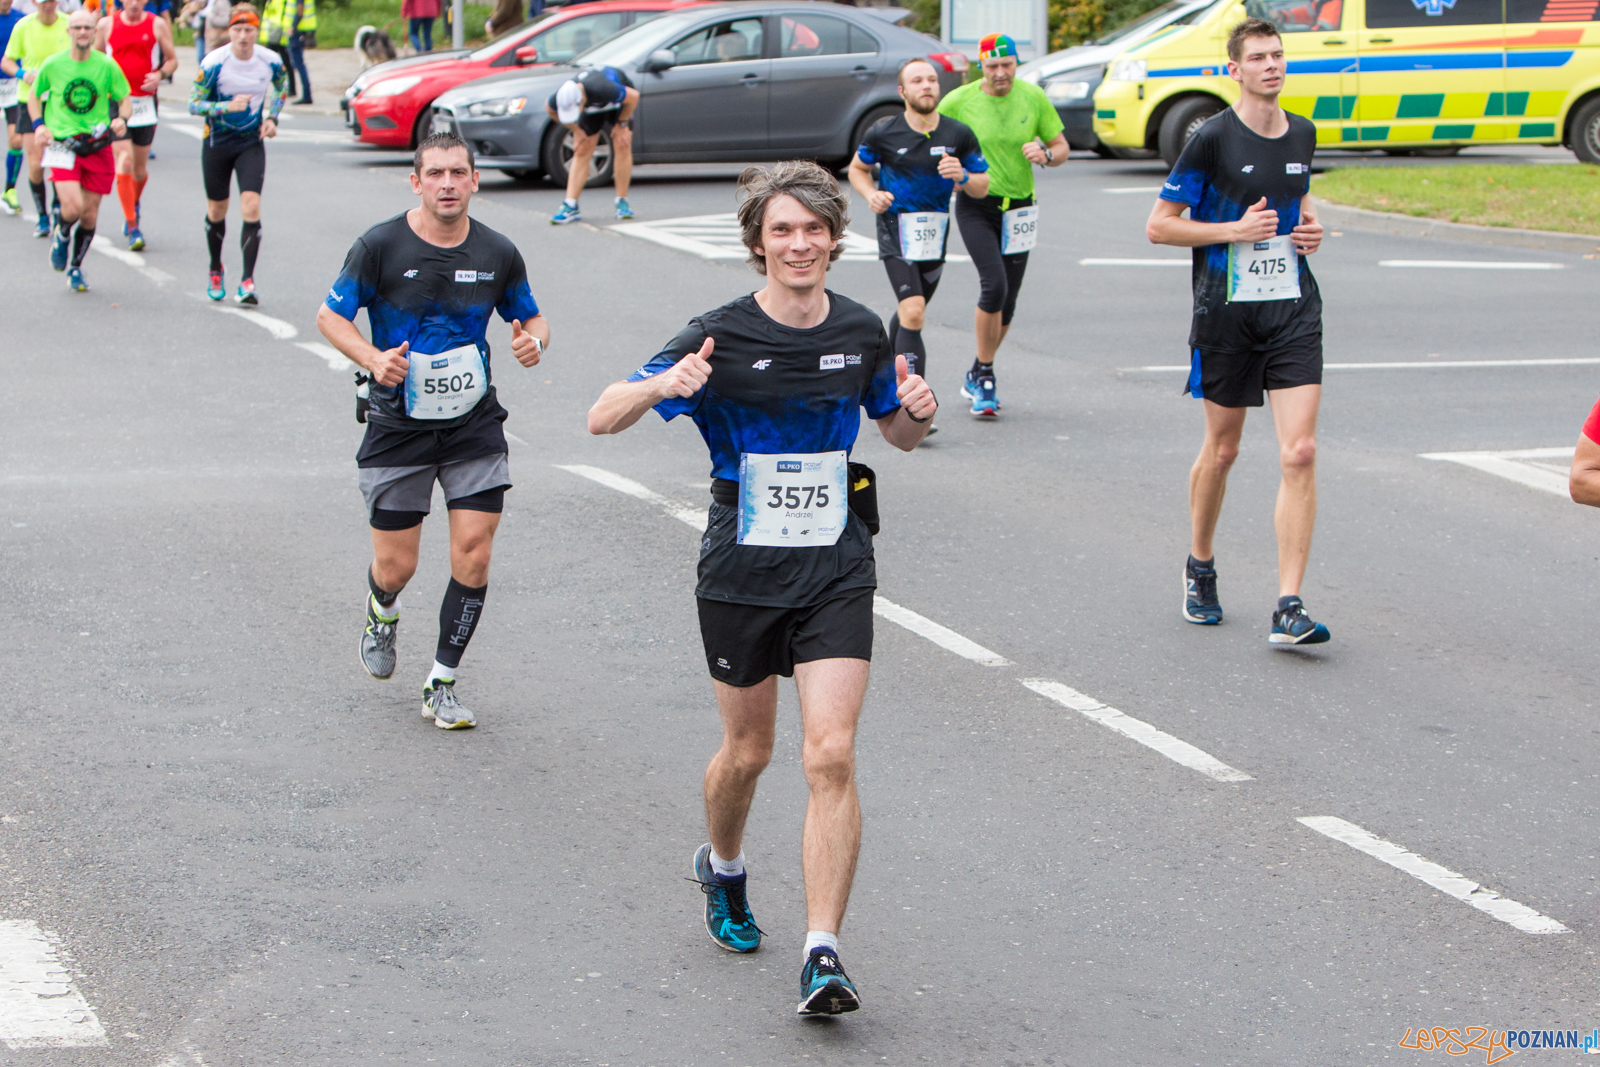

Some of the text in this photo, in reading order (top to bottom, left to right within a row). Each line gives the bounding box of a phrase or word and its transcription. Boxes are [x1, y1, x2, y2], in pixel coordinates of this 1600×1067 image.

[1013, 219, 1038, 235] 508
[914, 228, 937, 241] 3519
[1248, 257, 1287, 275] 4175
[403, 269, 419, 278] 4F
[752, 359, 772, 370] 4F
[830, 358, 843, 366] PKO
[424, 371, 475, 394] 5502
[437, 392, 463, 400] Grzegorz
[767, 484, 830, 509] 3575
[785, 511, 813, 519] Andrzej
